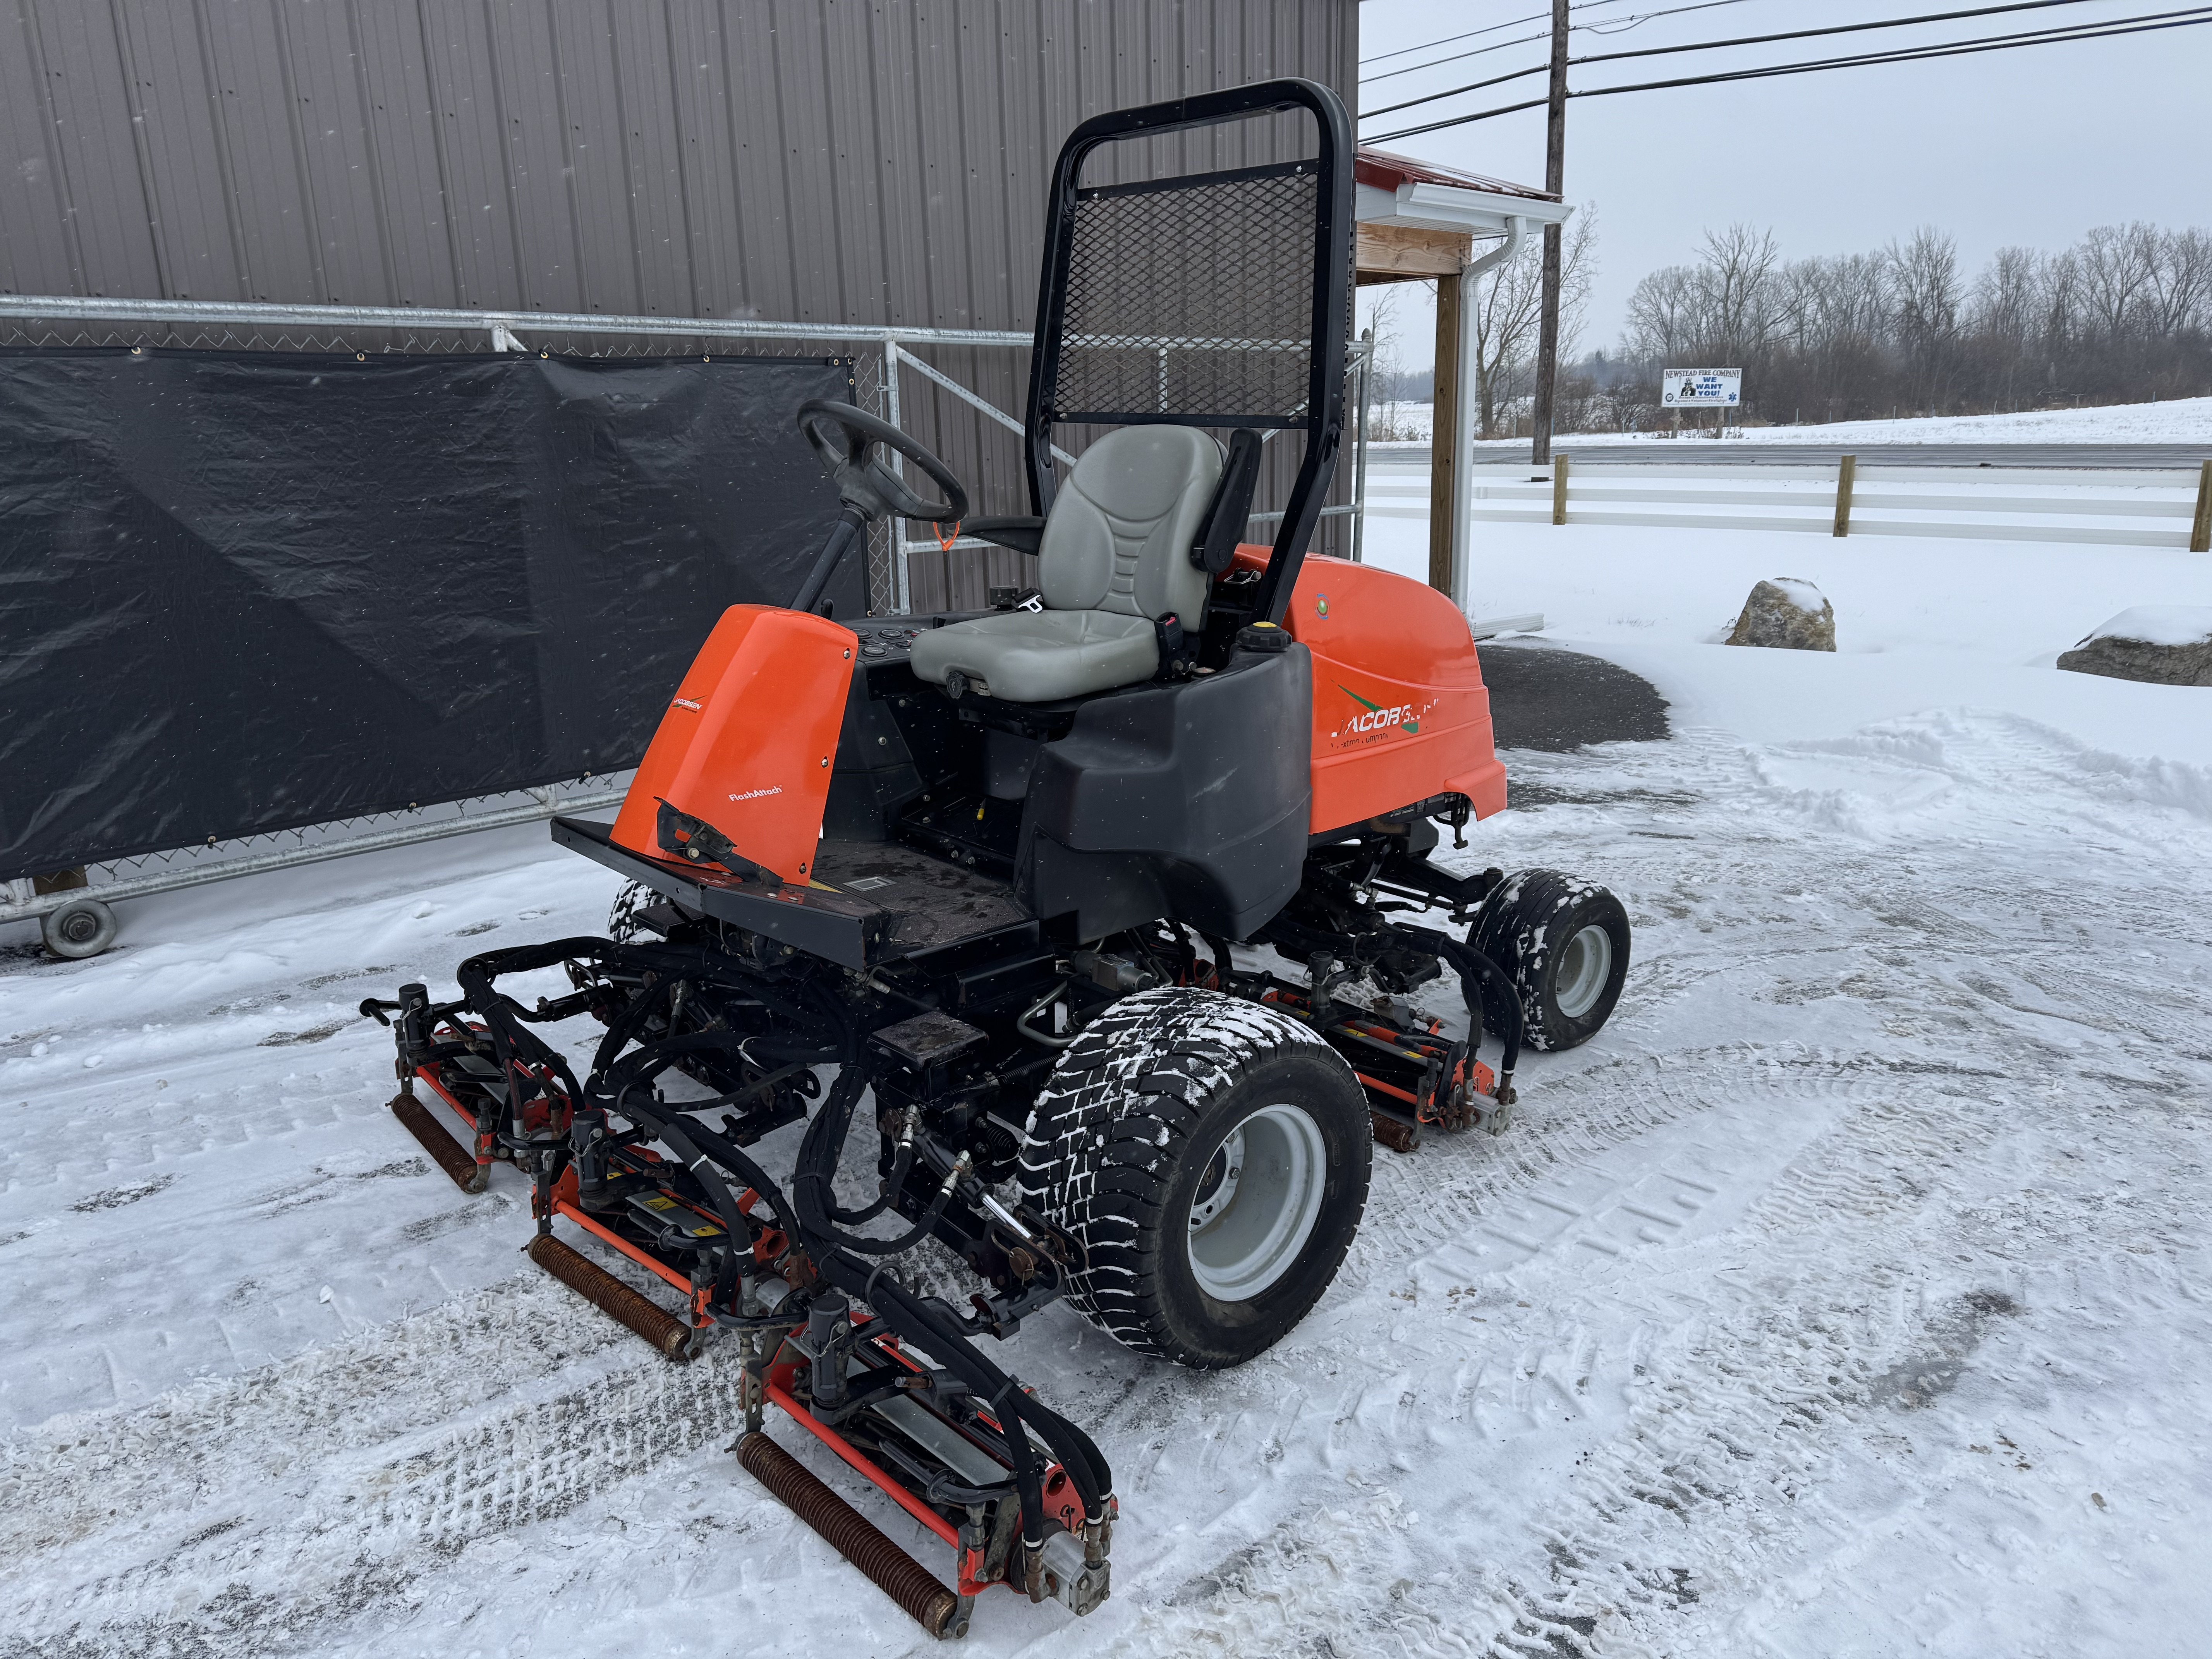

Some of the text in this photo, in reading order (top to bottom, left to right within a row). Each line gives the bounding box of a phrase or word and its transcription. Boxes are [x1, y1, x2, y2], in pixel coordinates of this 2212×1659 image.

[1666, 370, 1697, 379] NEWSTEAD
[1713, 370, 1740, 378] COMPANY
[673, 698, 702, 709] JACOBSEN
[728, 785, 783, 802] FlashAttach
